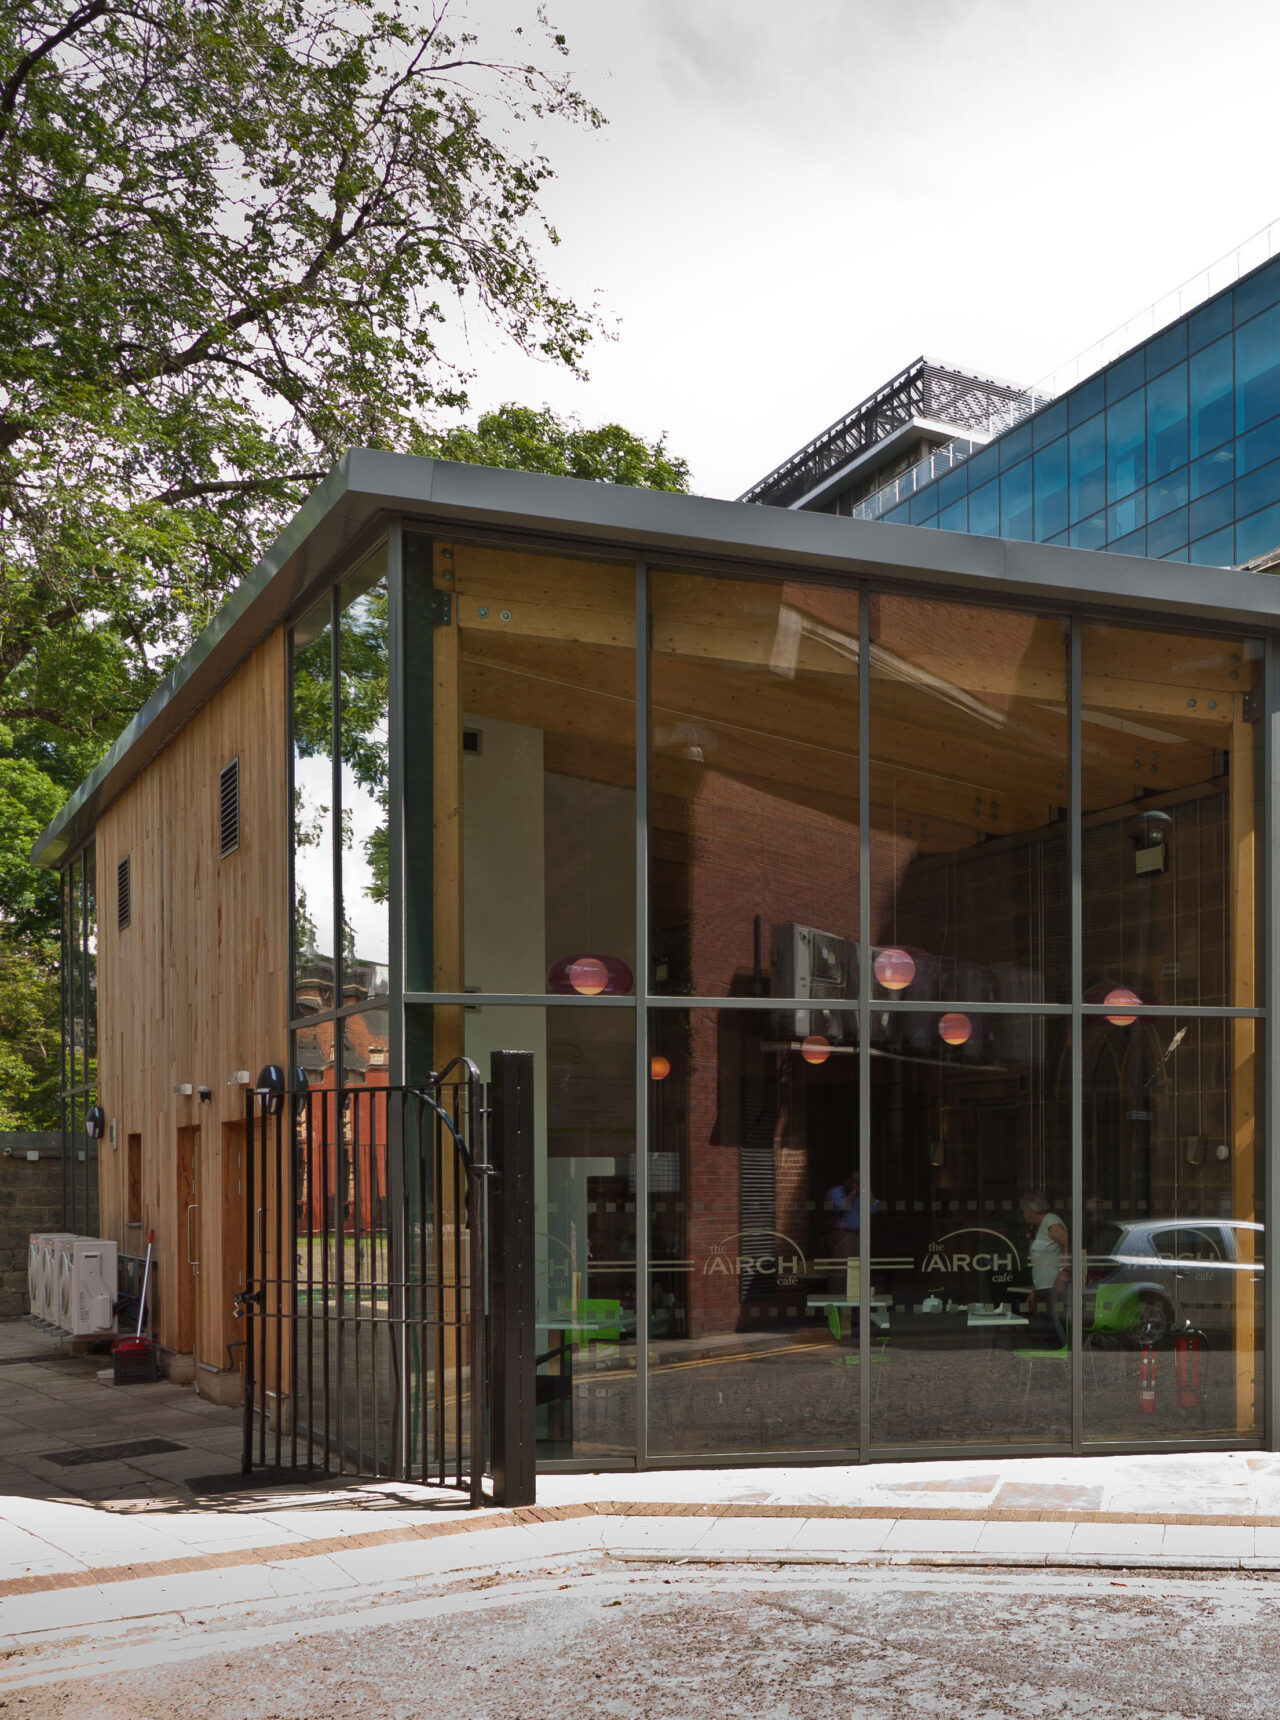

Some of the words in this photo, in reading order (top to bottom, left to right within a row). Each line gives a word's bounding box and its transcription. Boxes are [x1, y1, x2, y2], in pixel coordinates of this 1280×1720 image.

[710, 1242, 727, 1254] the
[928, 1242, 944, 1252] the
[708, 1256, 798, 1275] ARCH
[926, 1253, 1012, 1272] ARCH
[776, 1274, 798, 1286] café
[992, 1272, 1013, 1283] café
